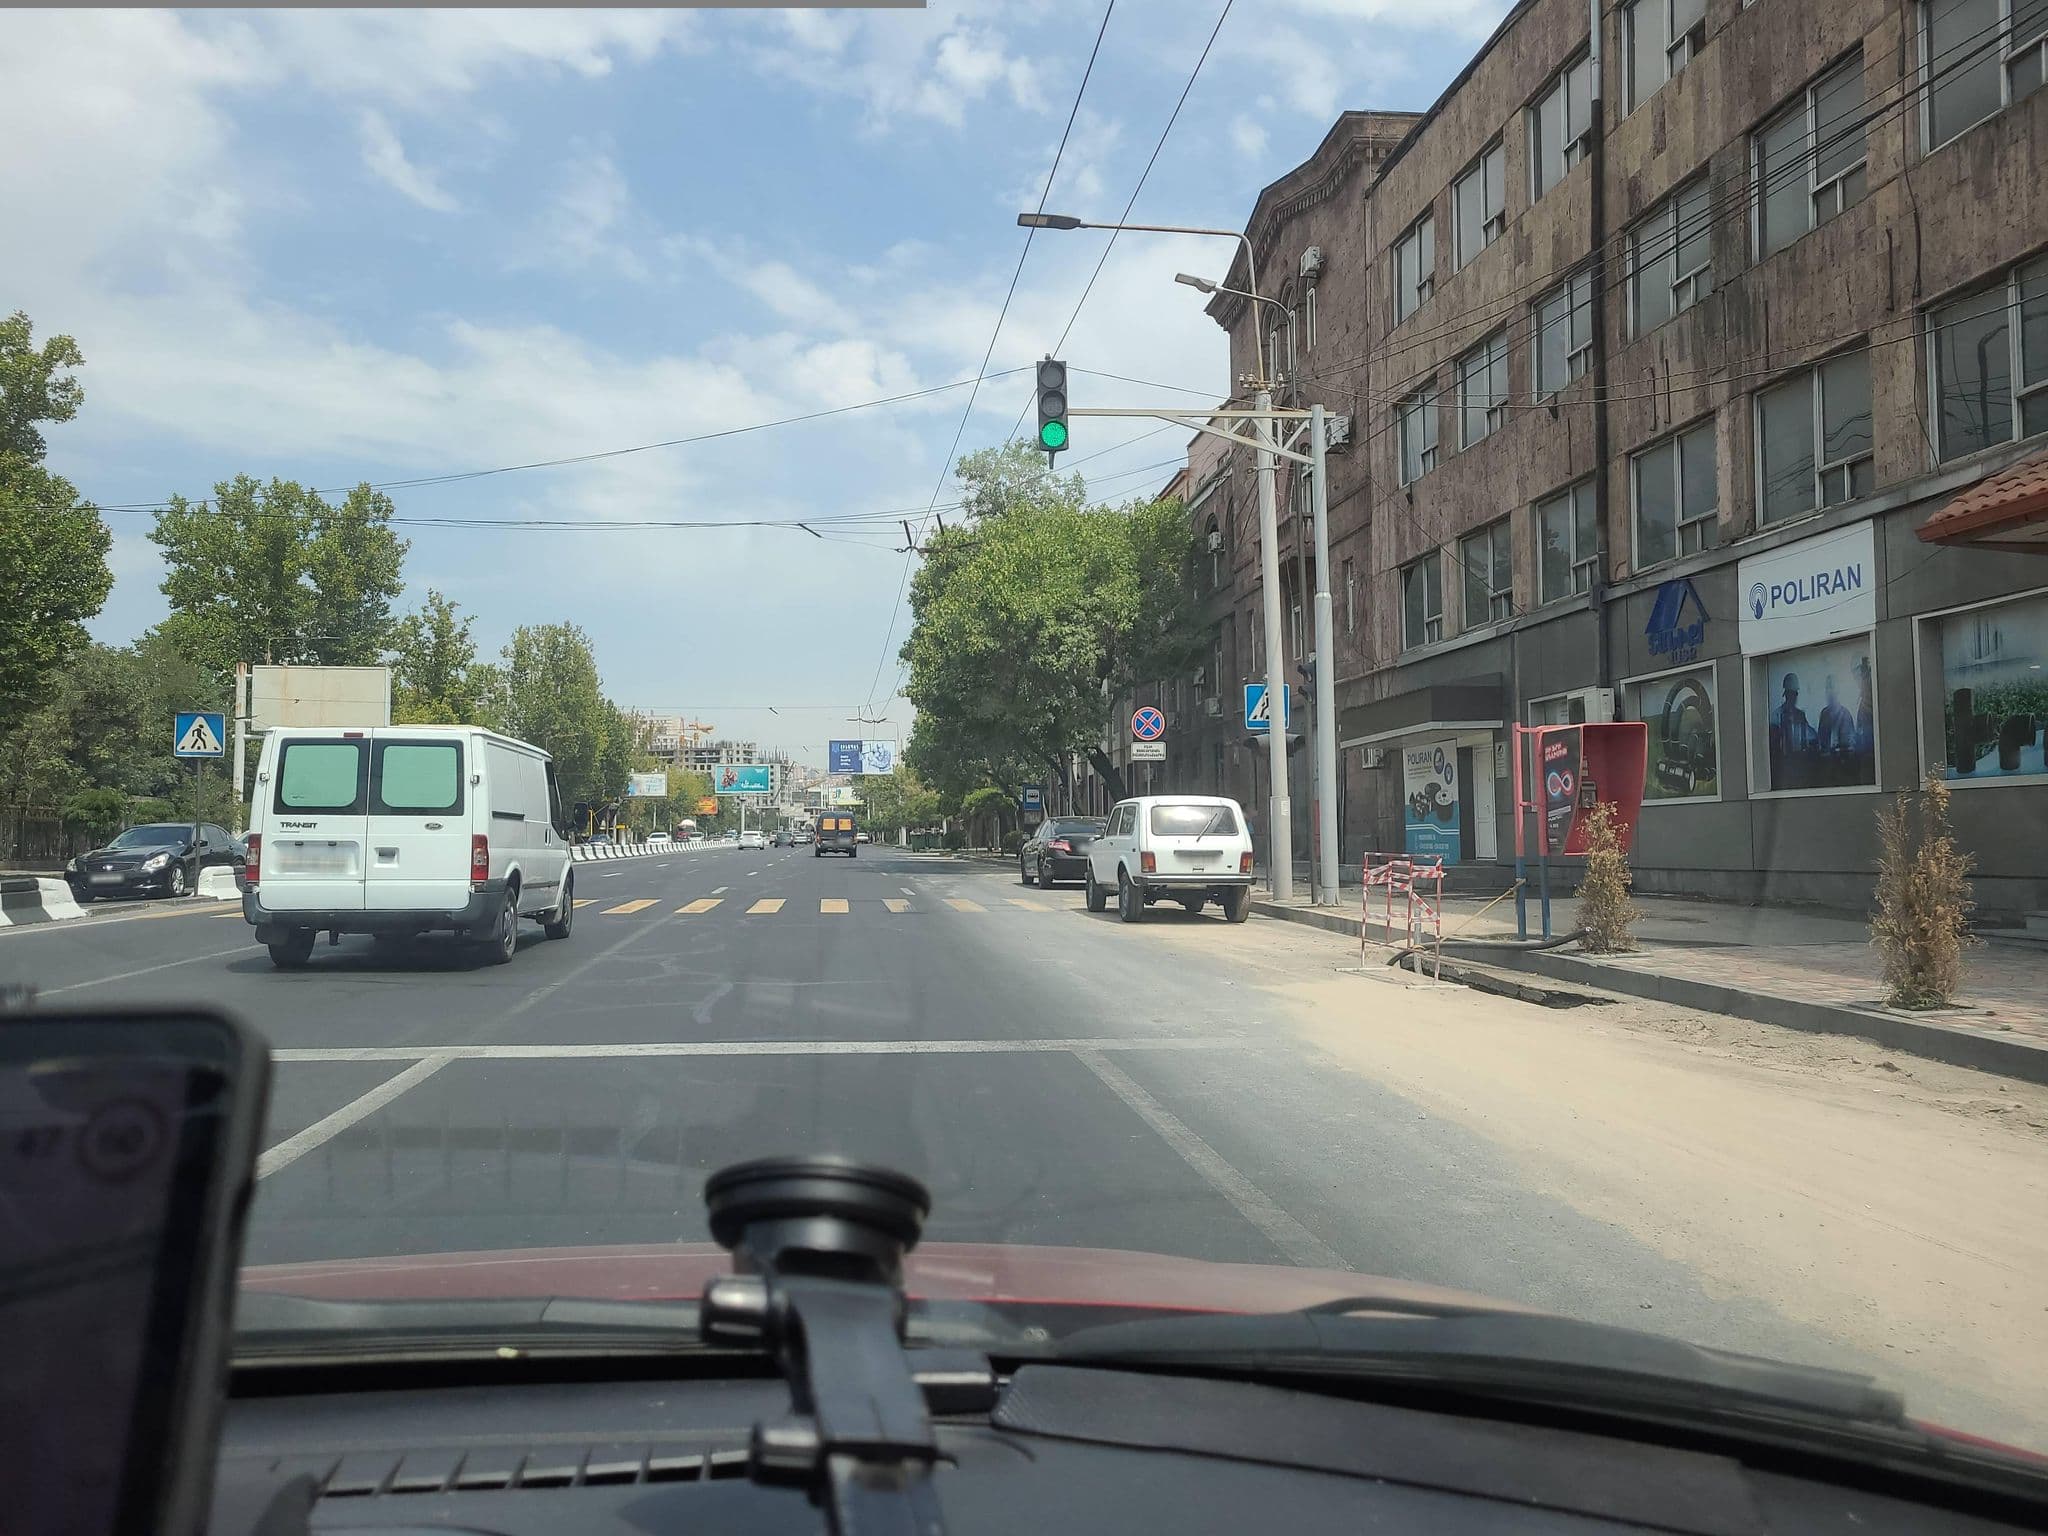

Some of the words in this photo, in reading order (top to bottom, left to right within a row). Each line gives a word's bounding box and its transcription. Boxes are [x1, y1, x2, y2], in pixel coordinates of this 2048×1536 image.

[1771, 563, 1861, 609] POLIRAN
[1407, 751, 1432, 765] POLIRAN
[279, 821, 318, 829] TRANSIT
